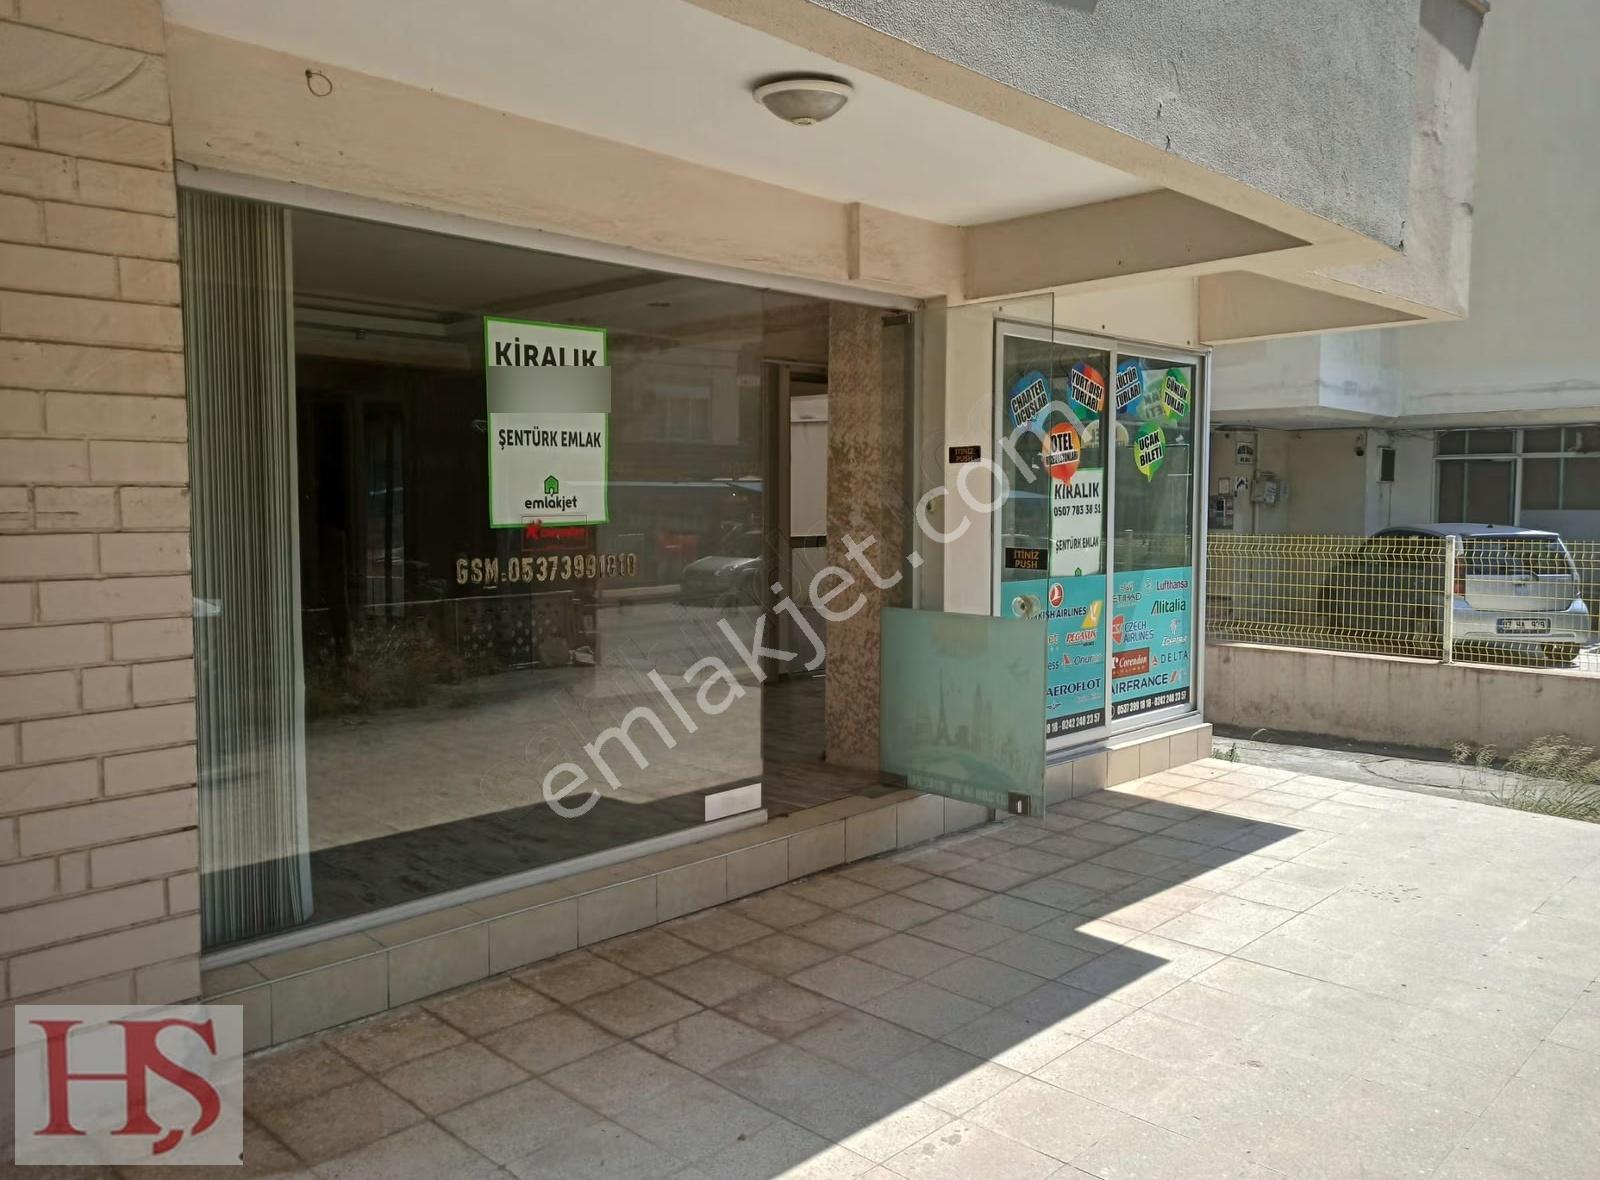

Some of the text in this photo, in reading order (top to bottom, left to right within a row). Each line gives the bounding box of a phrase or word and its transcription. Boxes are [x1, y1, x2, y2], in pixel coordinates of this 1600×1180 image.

[1072, 370, 1088, 390] YURT
[1011, 380, 1045, 413] CHARTER
[1072, 386, 1099, 412] TURLARI
[1164, 392, 1184, 415] TURLAR
[498, 426, 601, 450] ŞENTÜRK EMLAK
[1051, 432, 1073, 452] OTEL
[524, 495, 578, 512] emlakjet
[1053, 506, 1070, 517] 0507
[1072, 505, 1084, 516] 783
[1056, 536, 1081, 553] ŞENTÜRK
[1015, 560, 1038, 569] PUSH
[1156, 580, 1188, 590] Lufthansa
[1056, 606, 1087, 618] AIRLINES
[1151, 599, 1186, 615] Alitalia
[1125, 621, 1147, 632] CZECH
[1124, 630, 1154, 643] AIRLINES
[1161, 650, 1188, 664] DELTA
[1046, 679, 1101, 697] AEROFLOT
